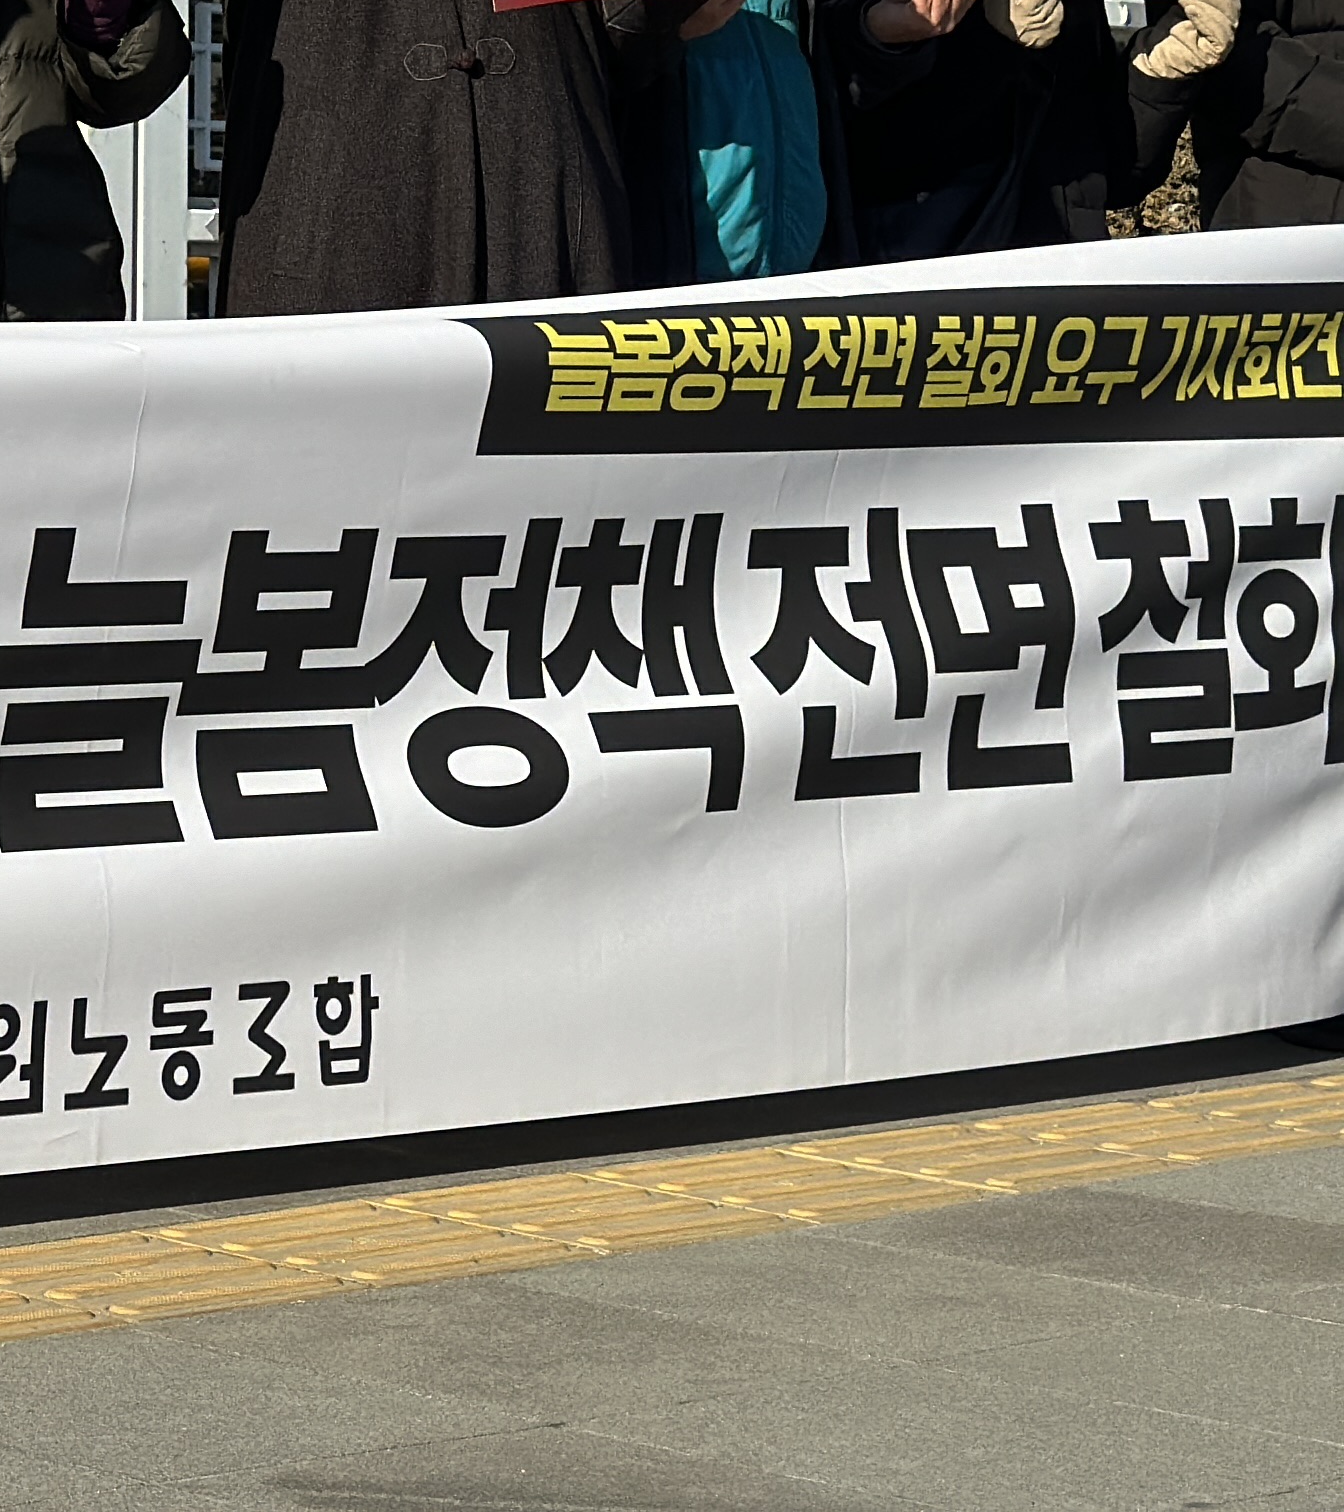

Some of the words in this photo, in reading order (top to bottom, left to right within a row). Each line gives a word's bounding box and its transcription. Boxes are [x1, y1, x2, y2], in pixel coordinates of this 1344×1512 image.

[534, 314, 790, 413] 늘봄정책
[797, 314, 918, 409] 전면
[919, 313, 1036, 409] 철회
[1028, 315, 1149, 405] 요구
[1140, 311, 1344, 402] 기자회견
[747, 503, 1076, 803] 전면
[1088, 494, 1344, 783] 철회
